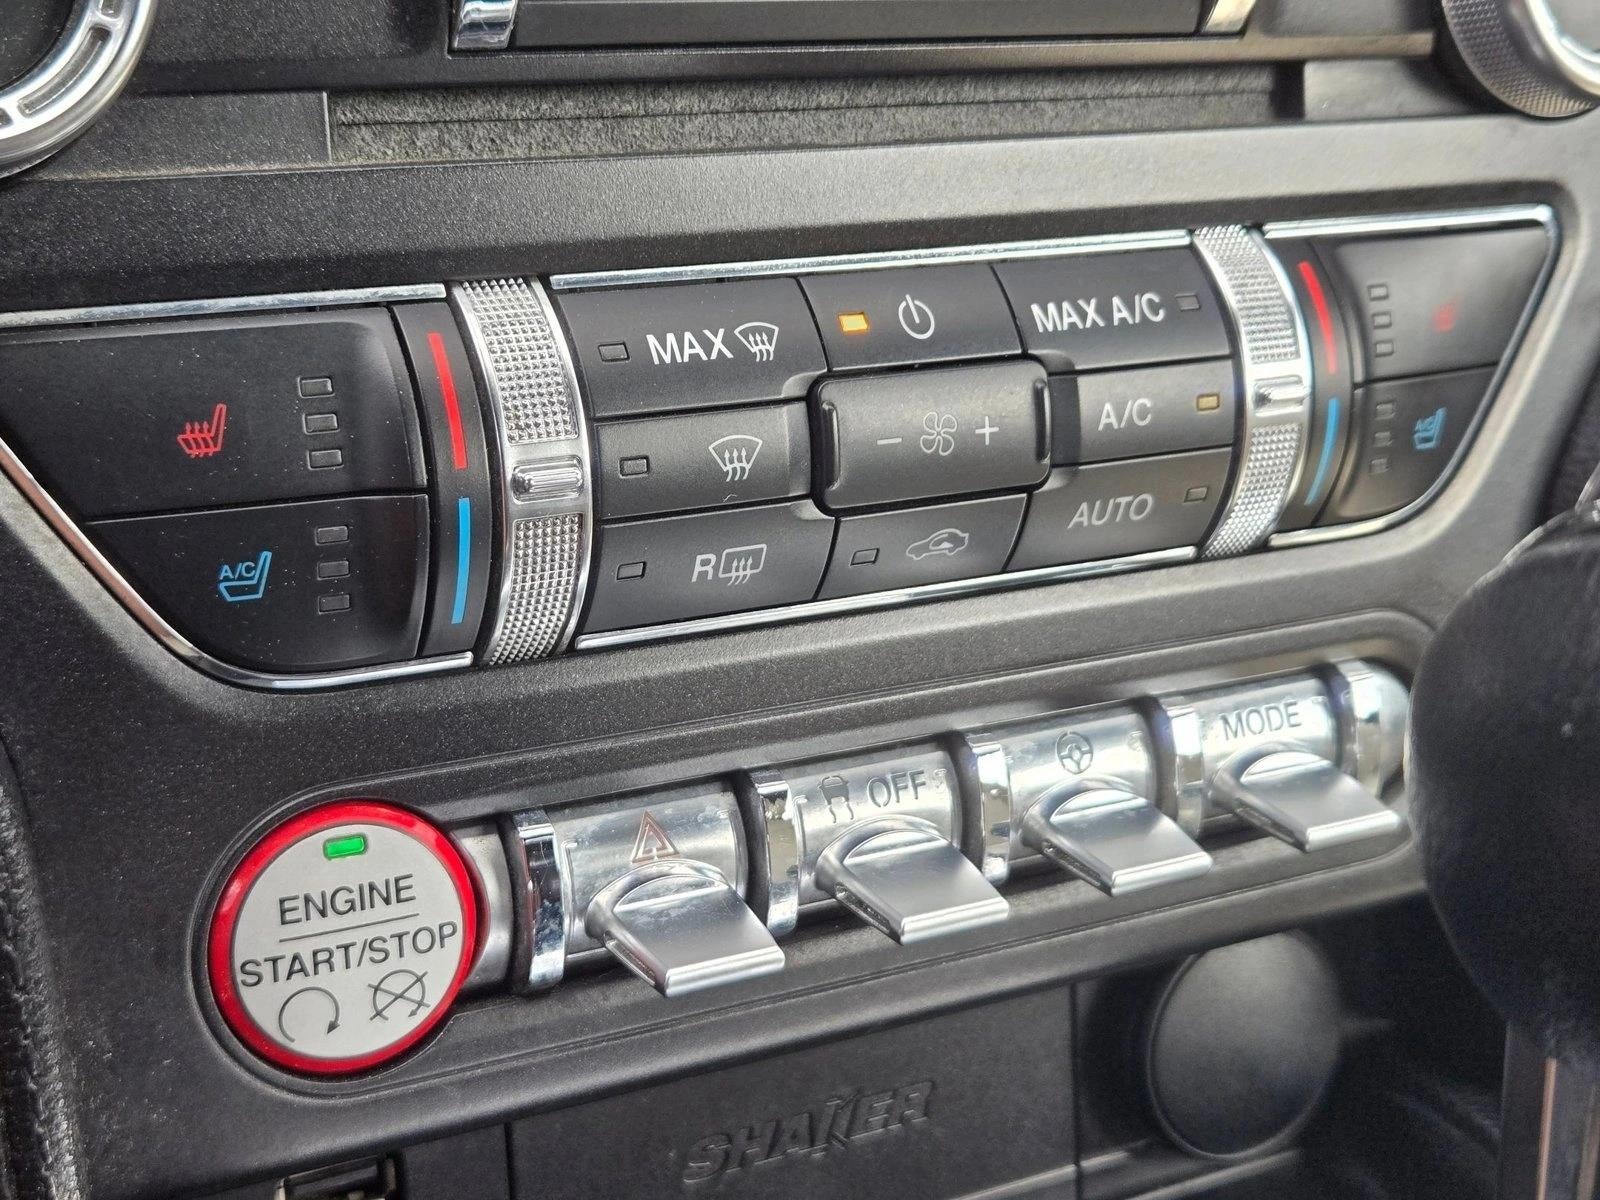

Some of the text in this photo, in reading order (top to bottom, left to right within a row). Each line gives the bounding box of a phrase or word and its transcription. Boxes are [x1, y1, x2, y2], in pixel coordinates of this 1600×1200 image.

[1030, 292, 1166, 333] MAX A/C
[646, 329, 734, 365] MAX
[1097, 398, 1153, 431] A/C
[1067, 493, 1153, 529] AUTO
[219, 561, 256, 580] A/C
[690, 552, 717, 582] R
[1221, 702, 1304, 741] MODE
[866, 771, 929, 808] OFF
[278, 874, 417, 926] ENGINE
[240, 920, 459, 987] START/STOP
[683, 1080, 936, 1183] SHAKER
